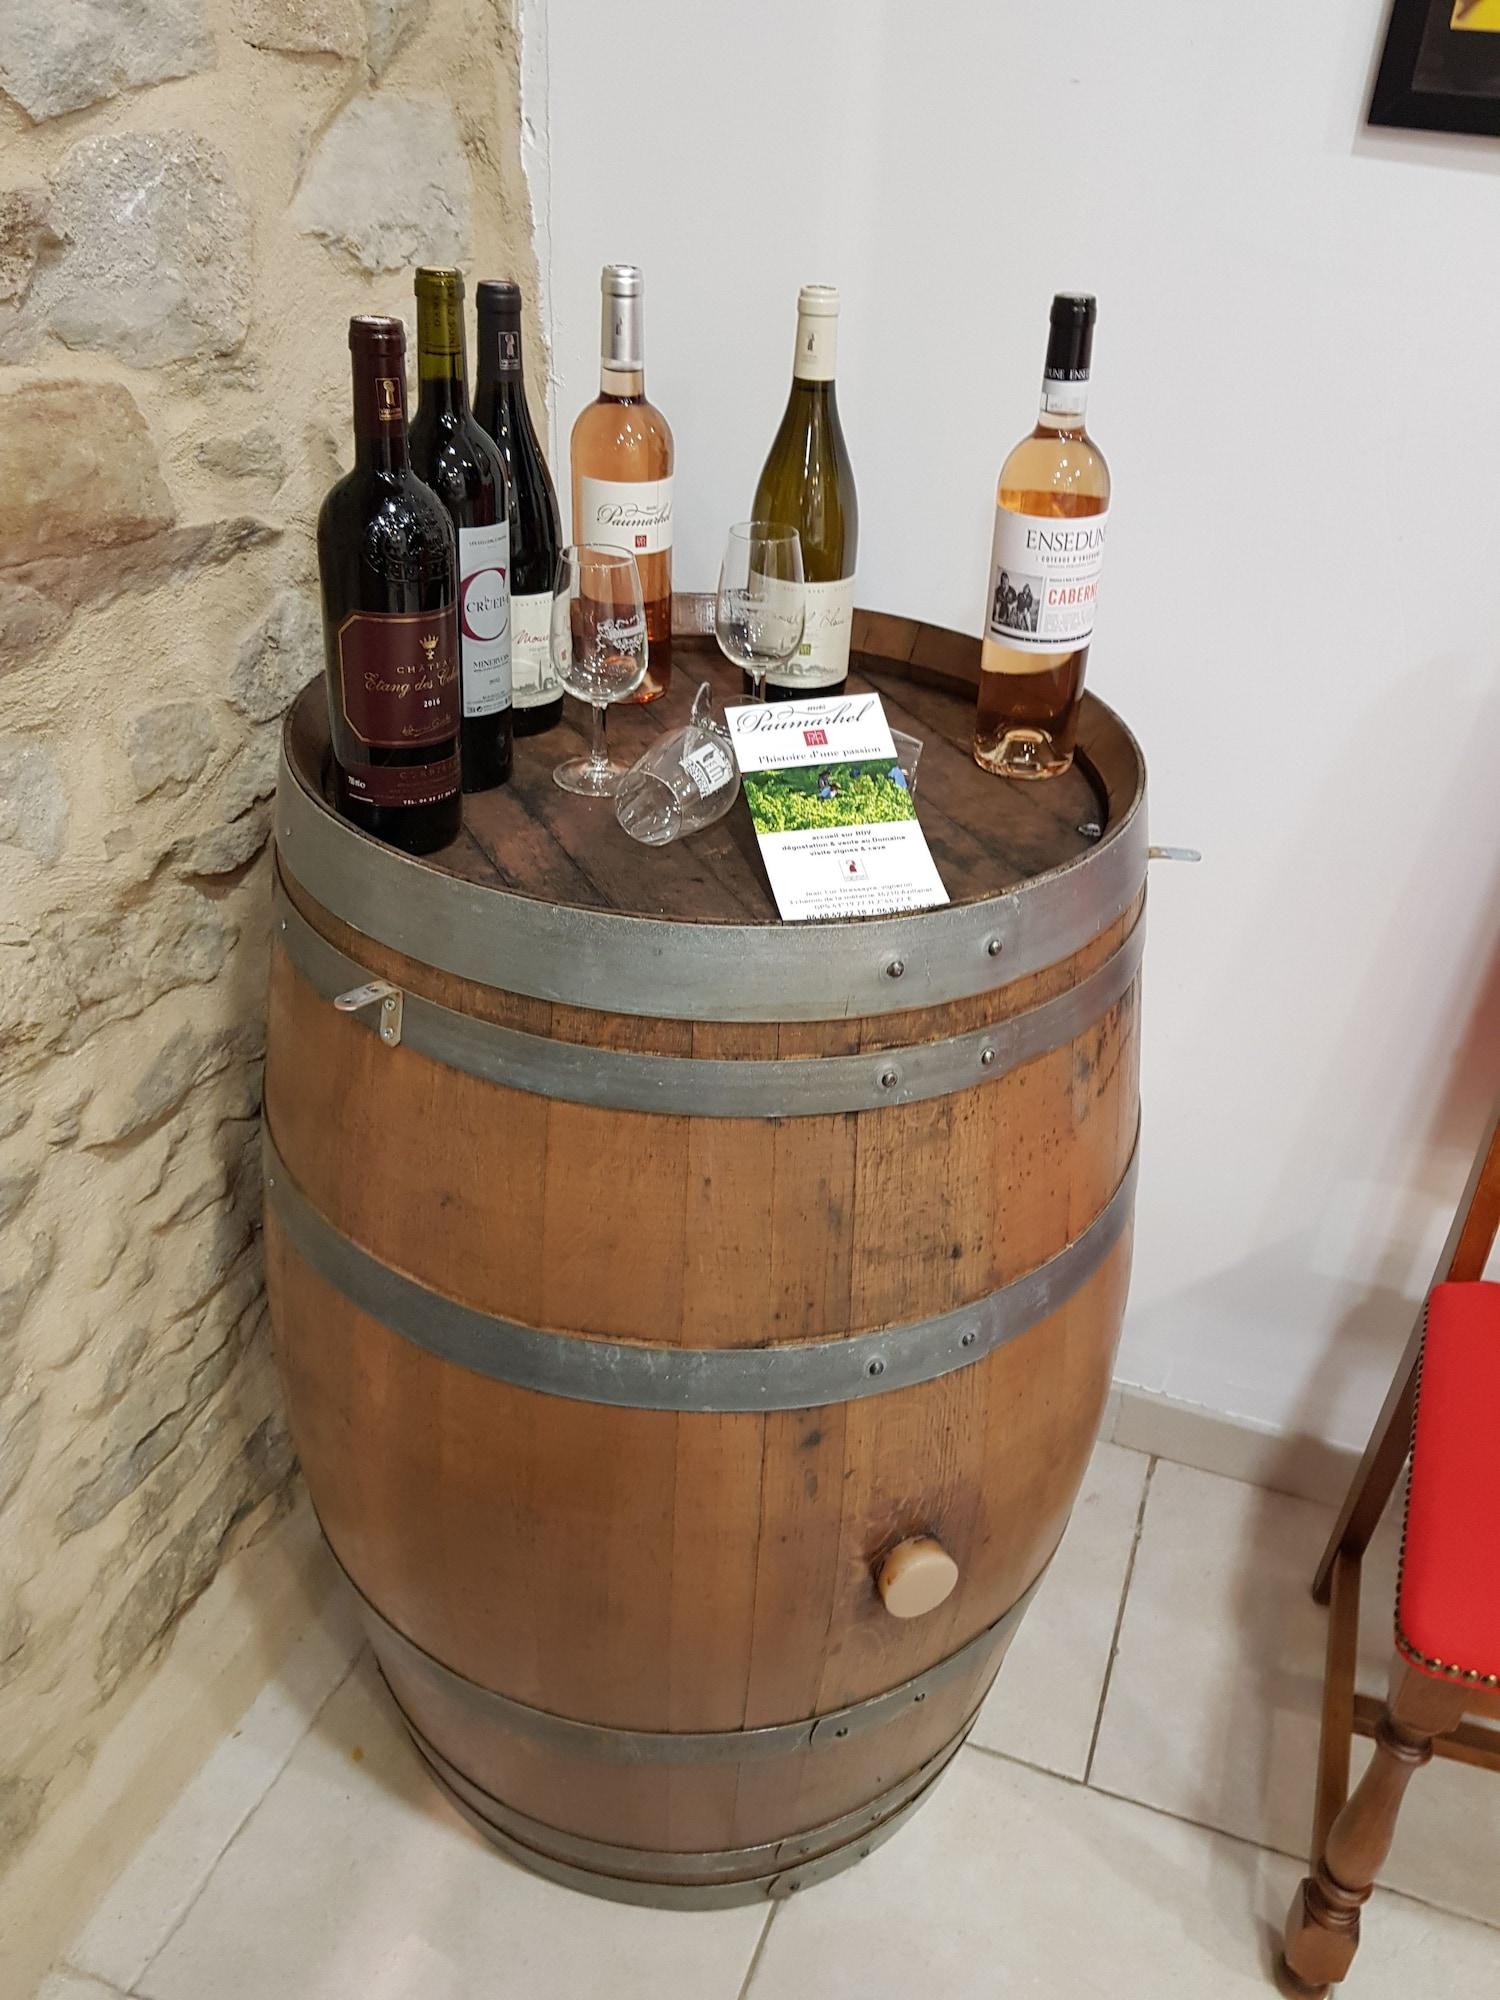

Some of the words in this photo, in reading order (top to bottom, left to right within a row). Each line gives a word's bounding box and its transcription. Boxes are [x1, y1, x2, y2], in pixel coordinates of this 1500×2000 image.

[423, 696, 441, 709] 2016
[736, 699, 876, 734] Paumarhel
[758, 753, 806, 765] l'histoire
[809, 749, 840, 760] d'une
[843, 745, 882, 758] passion
